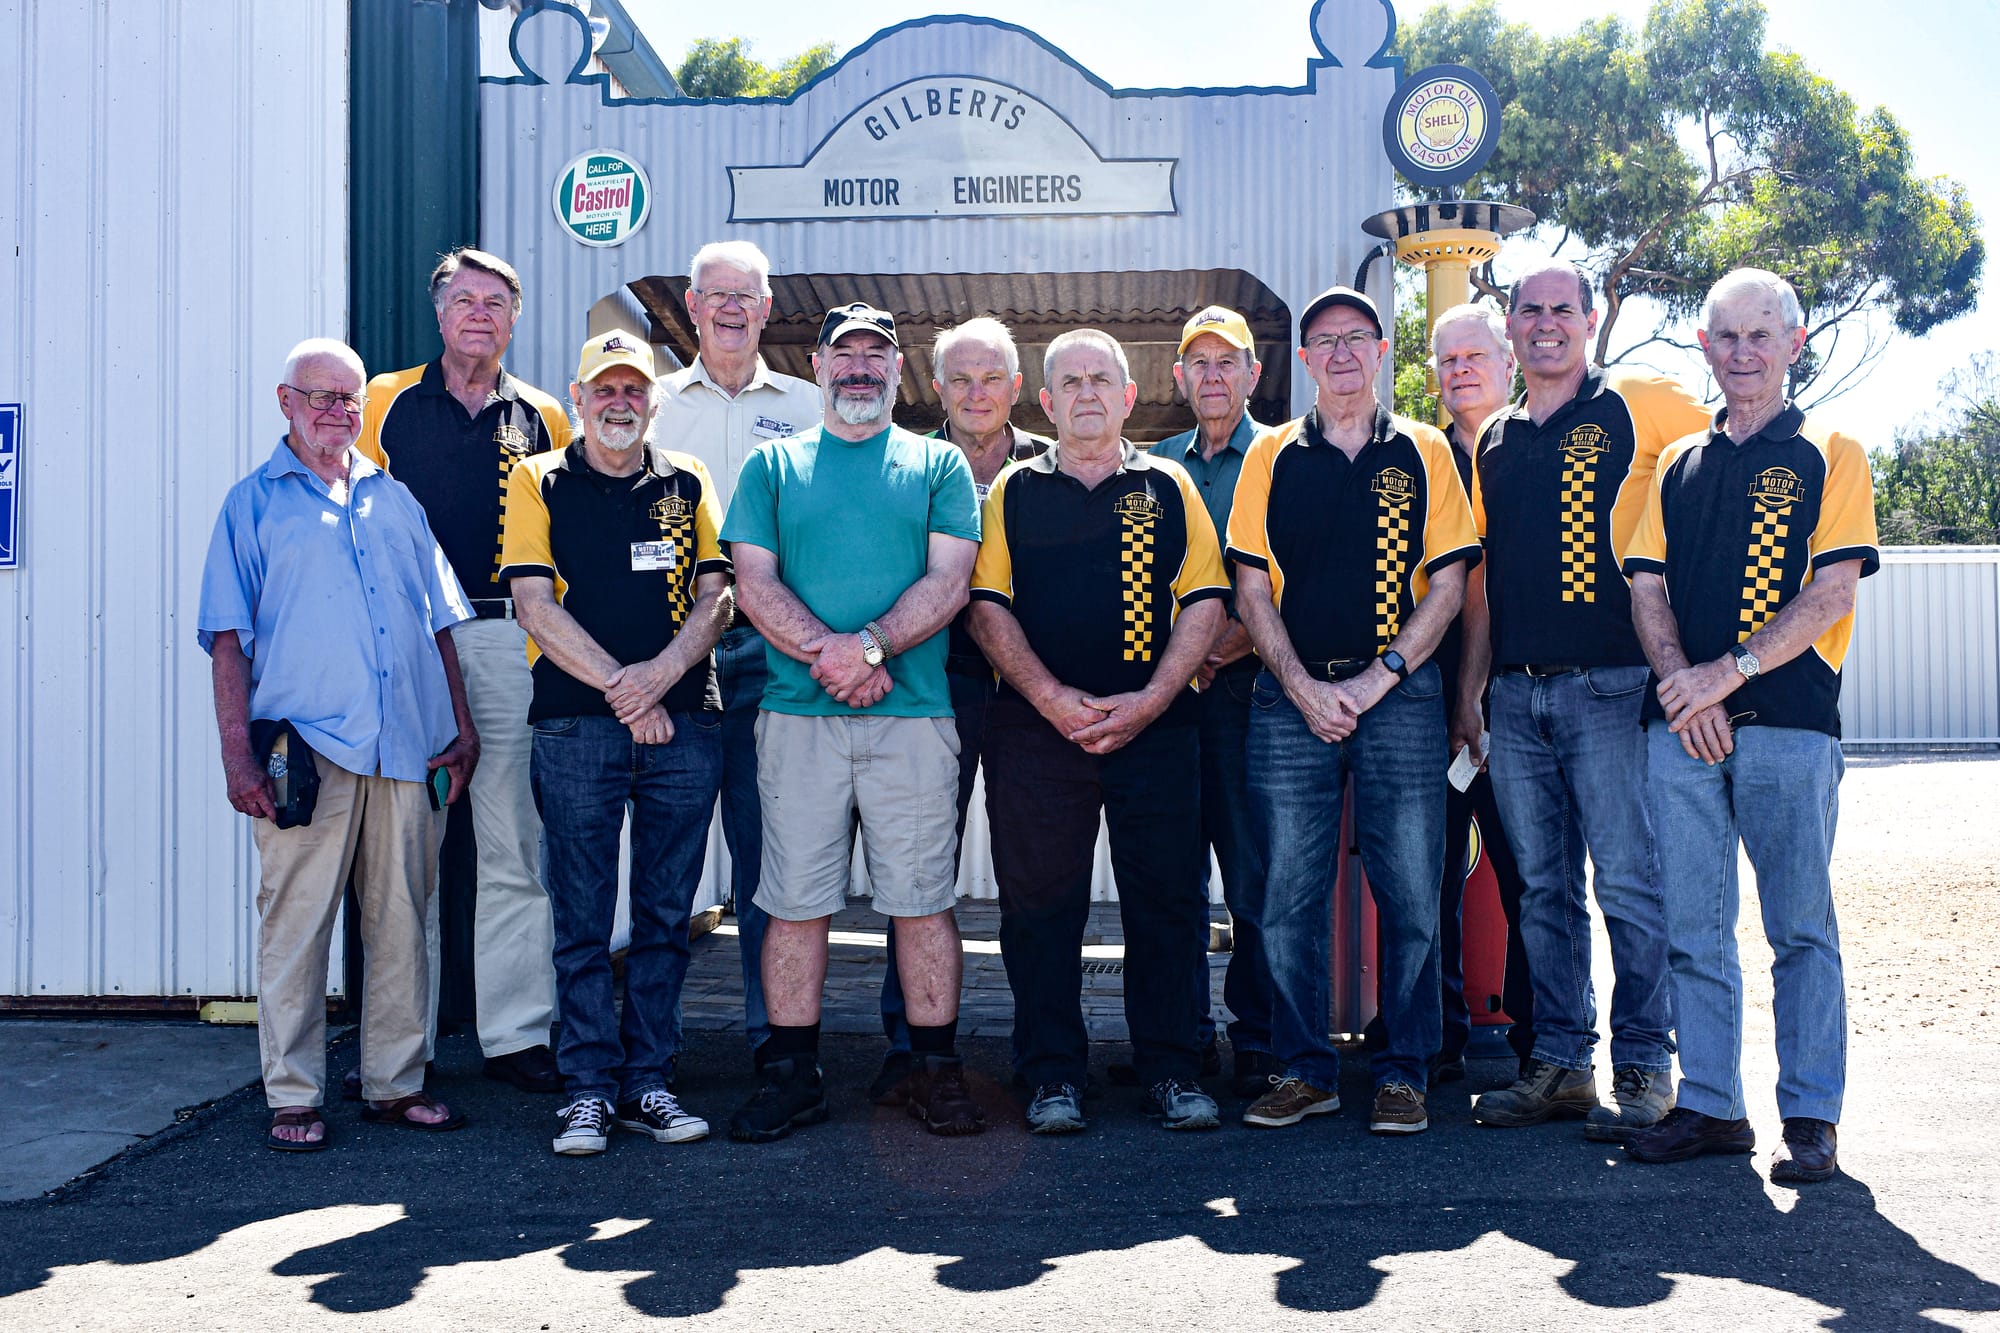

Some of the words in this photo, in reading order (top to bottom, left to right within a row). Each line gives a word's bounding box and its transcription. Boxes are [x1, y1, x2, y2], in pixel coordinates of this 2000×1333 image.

[1405, 84, 1455, 117] MOTOR
[1458, 89, 1477, 112] OIL
[863, 87, 1027, 142] GILBERTS
[1424, 113, 1460, 129] SHELL
[1409, 134, 1476, 165] GASOLINE
[588, 164, 606, 175] CALL
[608, 162, 624, 172] FOR
[587, 178, 625, 187] WAKEFIELD
[574, 178, 631, 213] Castrol
[824, 178, 900, 207] MOTOR
[953, 174, 1083, 205] ENGINEERS
[585, 222, 613, 236] HERE
[1571, 433, 1600, 442] MOTOR
[1382, 476, 1408, 487] MOTOR
[1762, 477, 1795, 489] MOTOR
[658, 502, 686, 512] MOTOR
[1126, 499, 1154, 509] MOTOR
